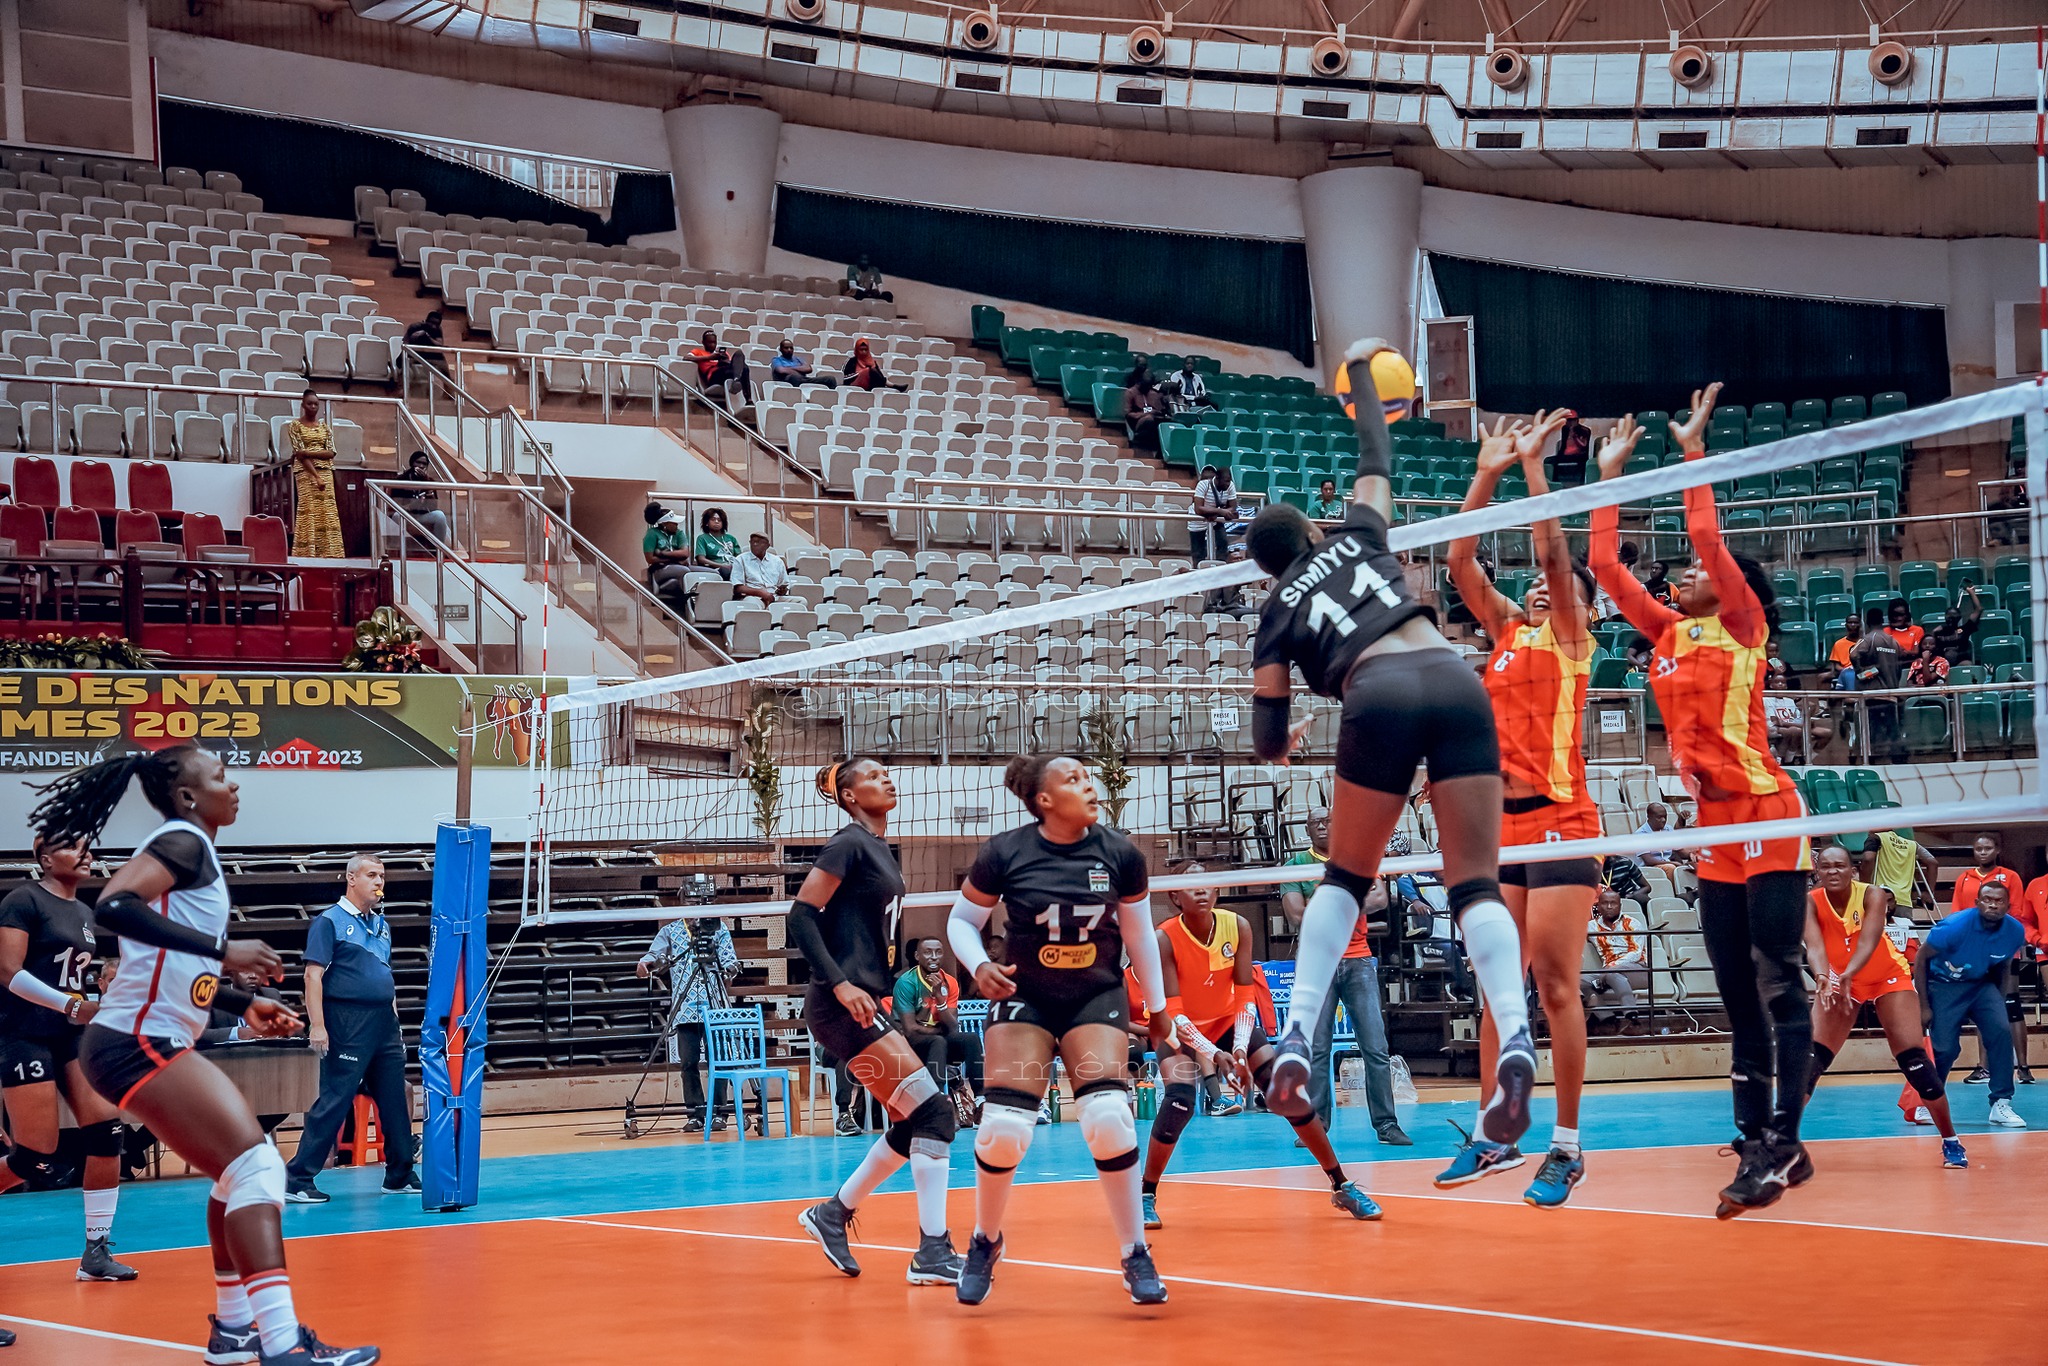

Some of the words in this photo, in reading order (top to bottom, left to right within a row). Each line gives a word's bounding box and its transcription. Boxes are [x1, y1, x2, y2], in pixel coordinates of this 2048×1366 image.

[1280, 535, 1362, 608] SIMIYU
[1307, 561, 1402, 638] 11
[0, 676, 23, 704] E
[37, 677, 149, 705] DES
[162, 678, 402, 706] NATIONS
[1, 709, 121, 738] MES
[134, 711, 261, 738] 2023
[0, 751, 104, 767] FANDENA
[227, 750, 251, 765] 25
[256, 746, 312, 765] AOÛT
[317, 750, 363, 765] 2023
[1035, 903, 1106, 942] 17
[53, 946, 92, 991] 13
[1203, 973, 1215, 987] 4
[990, 1001, 1026, 1021] 17
[14, 1060, 45, 1080] 13
